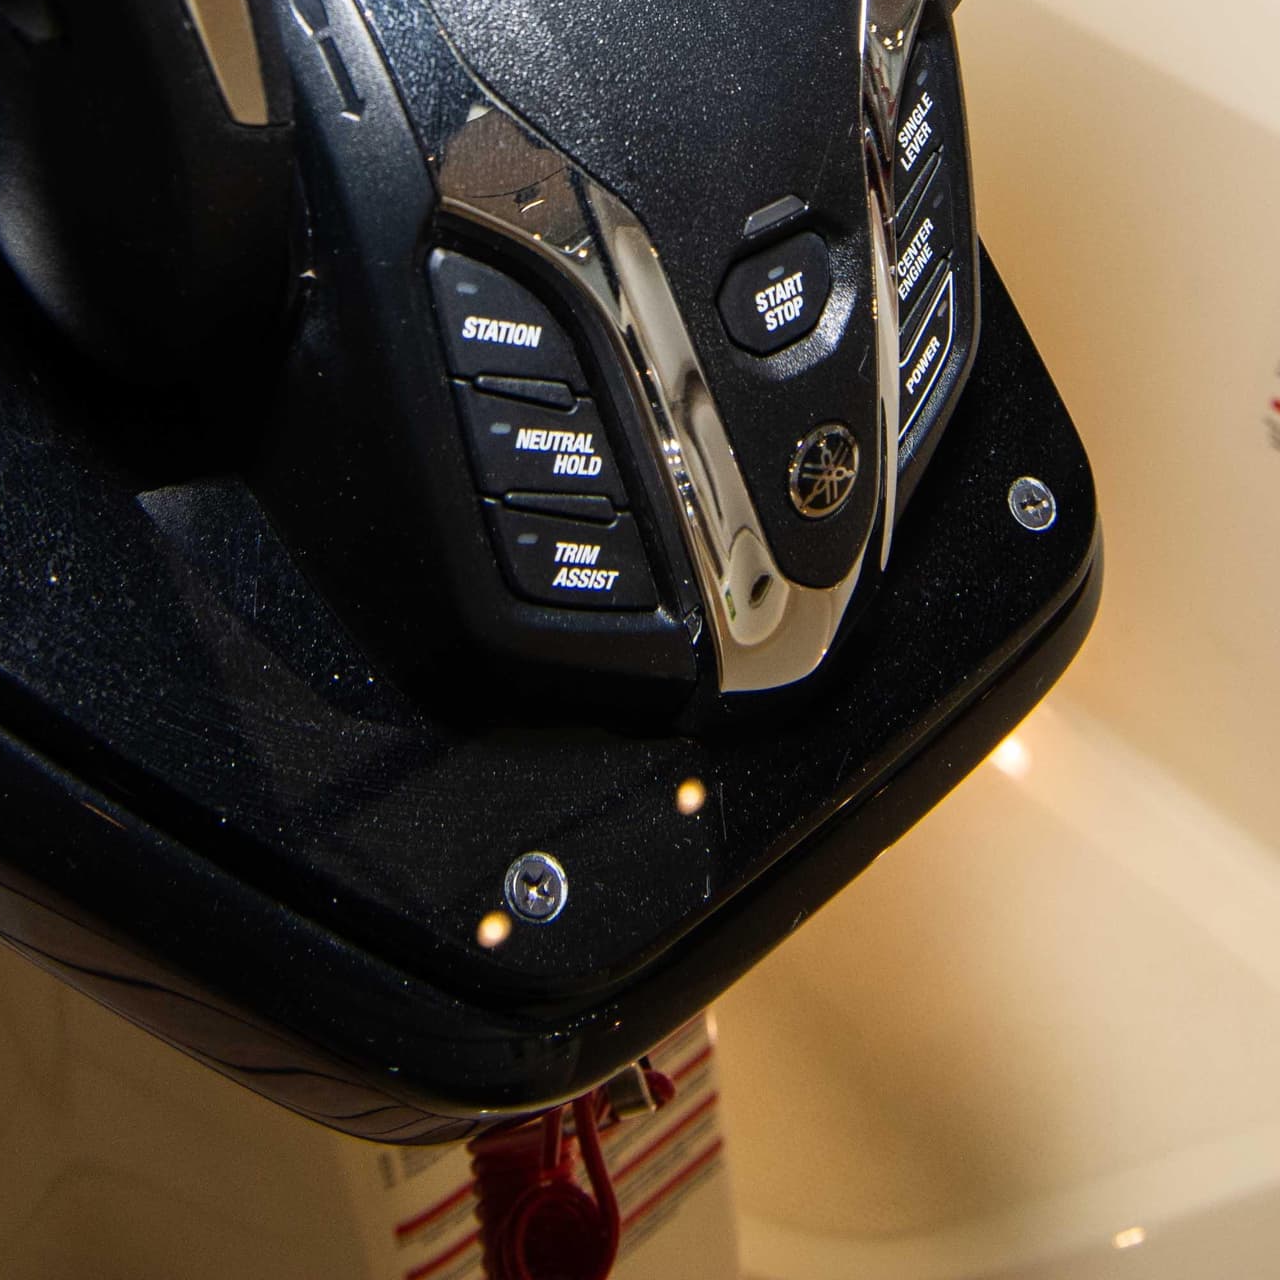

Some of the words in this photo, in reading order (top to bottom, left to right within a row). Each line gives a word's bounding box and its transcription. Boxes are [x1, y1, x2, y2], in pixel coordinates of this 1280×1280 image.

[898, 91, 933, 148] SINGLE
[901, 121, 932, 172] LEVER
[898, 217, 934, 277] CENTER
[898, 242, 933, 300] ENGINE
[755, 271, 803, 313] START
[461, 316, 542, 348] STATION
[765, 295, 803, 331] STOP
[905, 335, 941, 395] POWER
[515, 428, 595, 454] NEUTRAL
[552, 452, 602, 476] HOLD
[554, 542, 601, 566] TRIM
[552, 567, 620, 590] ASSIST
